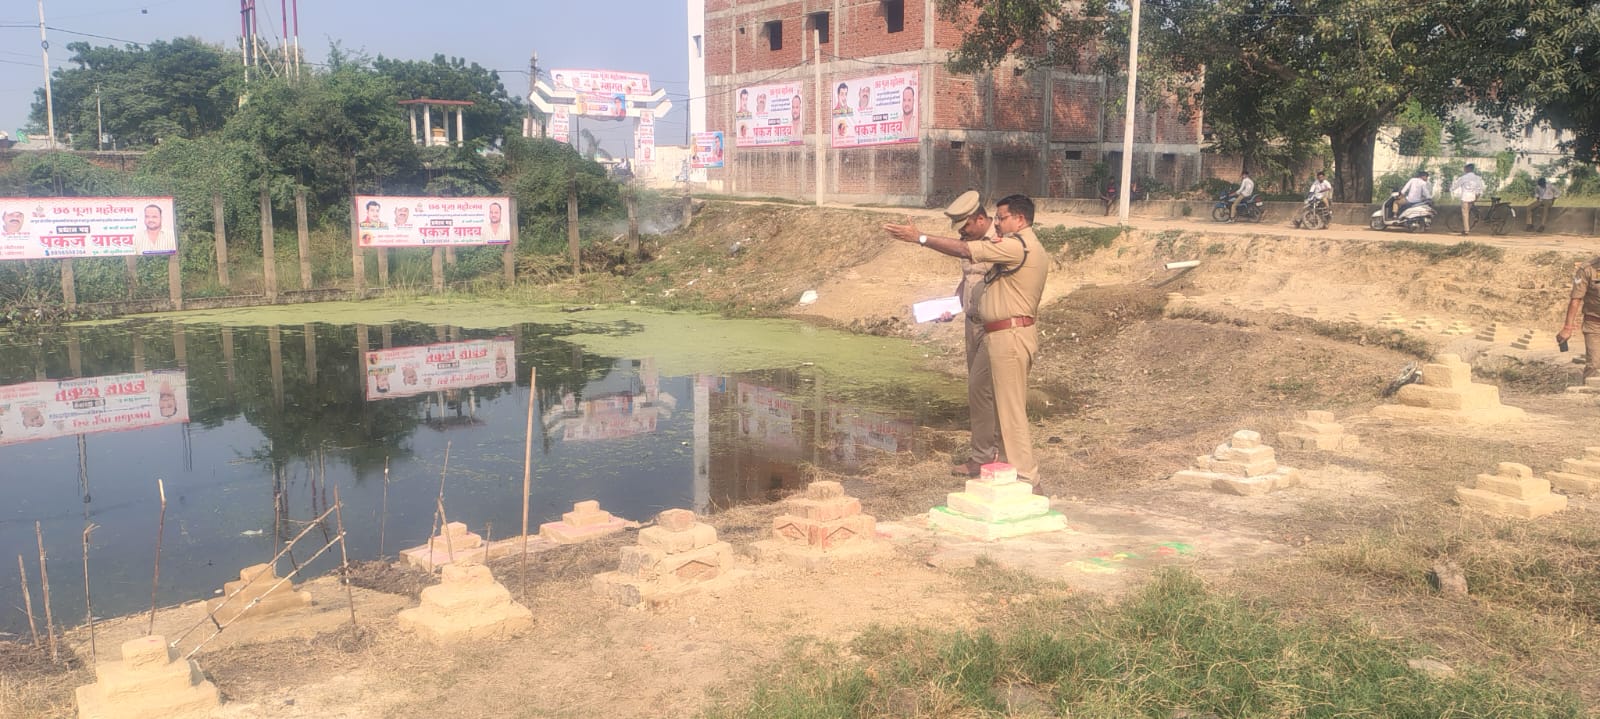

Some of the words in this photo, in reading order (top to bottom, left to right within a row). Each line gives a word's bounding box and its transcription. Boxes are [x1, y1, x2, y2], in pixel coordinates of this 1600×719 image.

[773, 126, 792, 137] यादव
[854, 120, 877, 136] पंकज
[880, 121, 903, 133] यादव
[53, 206, 70, 215] छठ
[72, 206, 93, 217] पूजा
[96, 204, 134, 215] महोत्सव
[441, 203, 455, 212] पूजा
[418, 223, 450, 237] पंकज
[453, 226, 482, 237] यादव
[40, 231, 87, 248] पंकज
[91, 234, 134, 248] यादव
